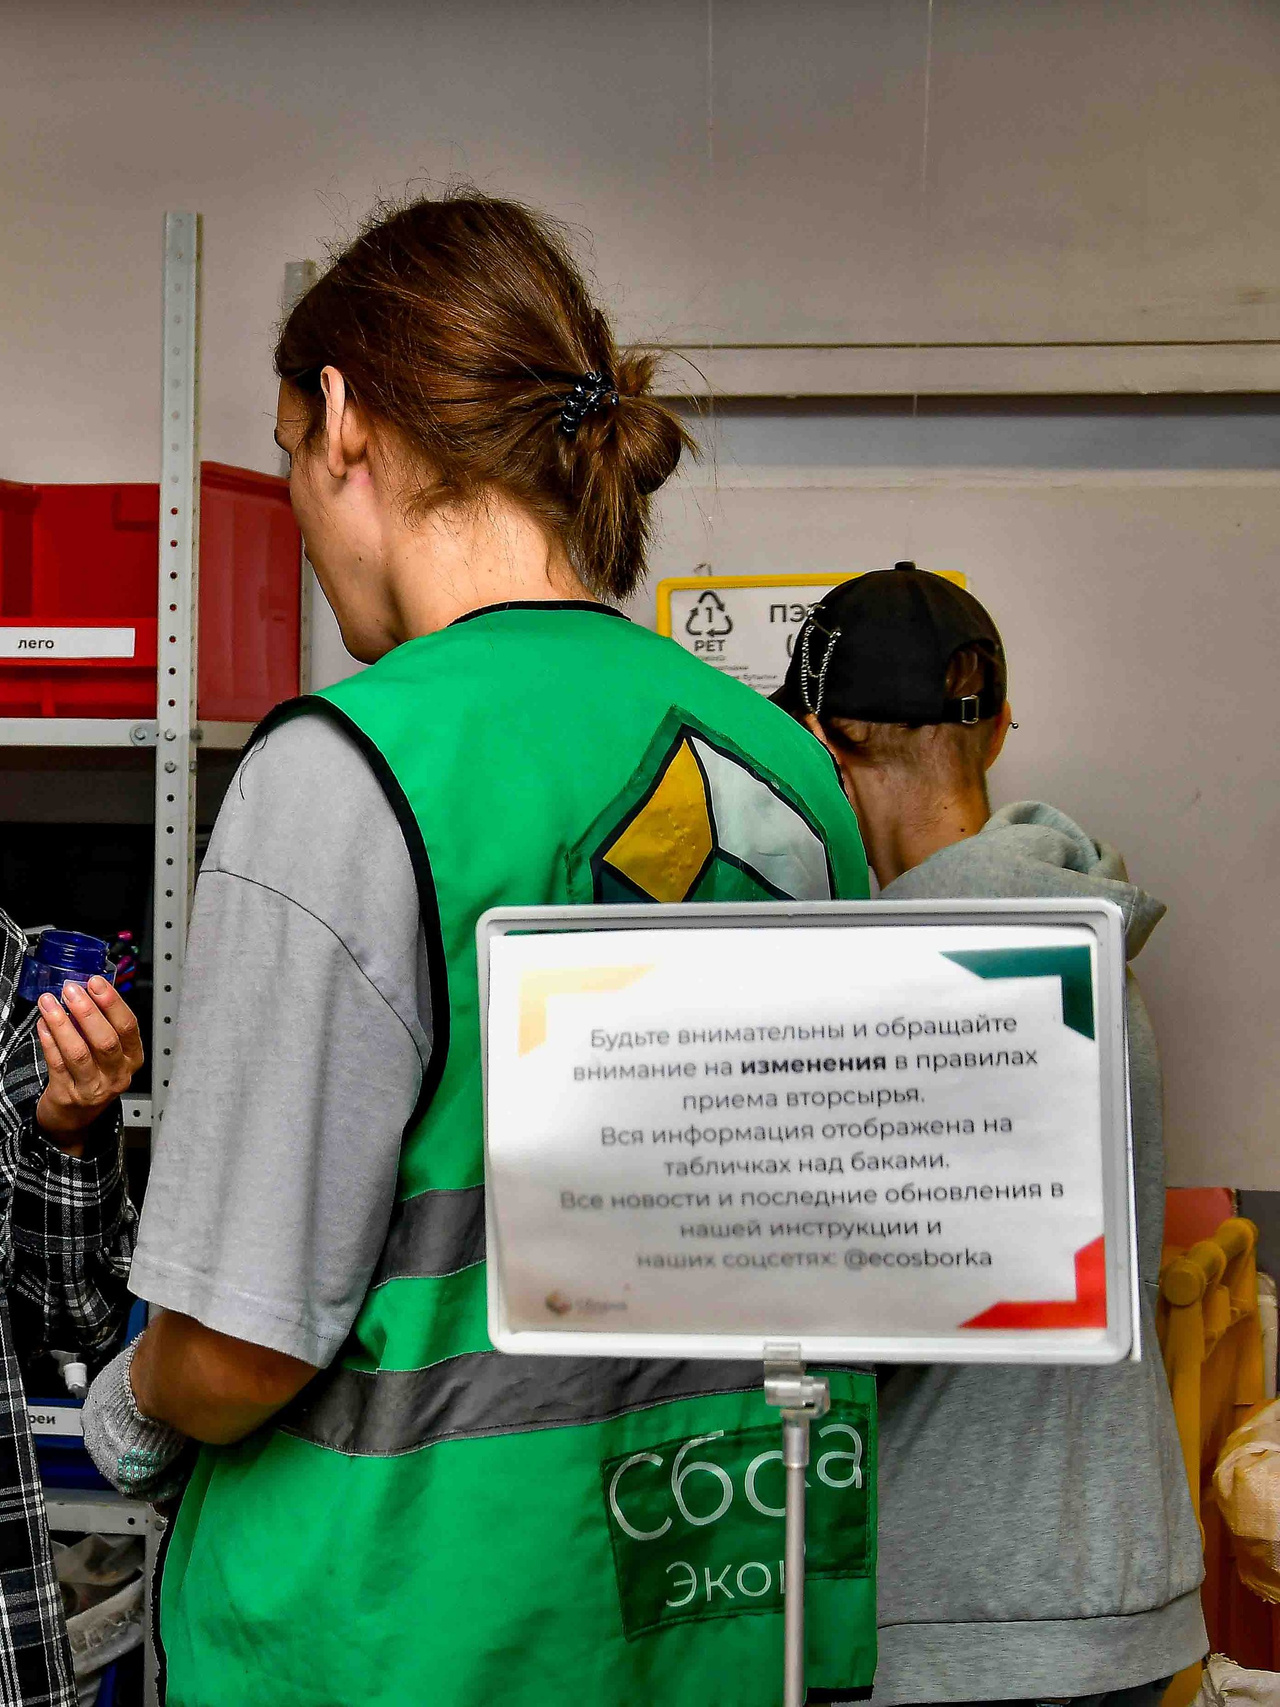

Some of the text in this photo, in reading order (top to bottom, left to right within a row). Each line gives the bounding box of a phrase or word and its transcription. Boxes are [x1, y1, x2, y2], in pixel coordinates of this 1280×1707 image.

[18, 638, 55, 649] лего
[694, 639, 726, 652] PET
[590, 1014, 1018, 1051] Будьте внимательны и обращайте
[573, 1049, 1038, 1081] внимание на изменения в правилах
[682, 1087, 925, 1113] приема вторсырья.
[600, 1117, 1013, 1147] Вся информация отображена на
[664, 1151, 950, 1177] табличках над баками.
[559, 1182, 1064, 1210] Все новости и последние обновления в
[680, 1218, 942, 1240] нашей инструкции и
[636, 1252, 717, 1269] наших
[844, 1248, 992, 1271] @ecosborka
[609, 1423, 863, 1541] Сбоа
[665, 1560, 786, 1607] эко
